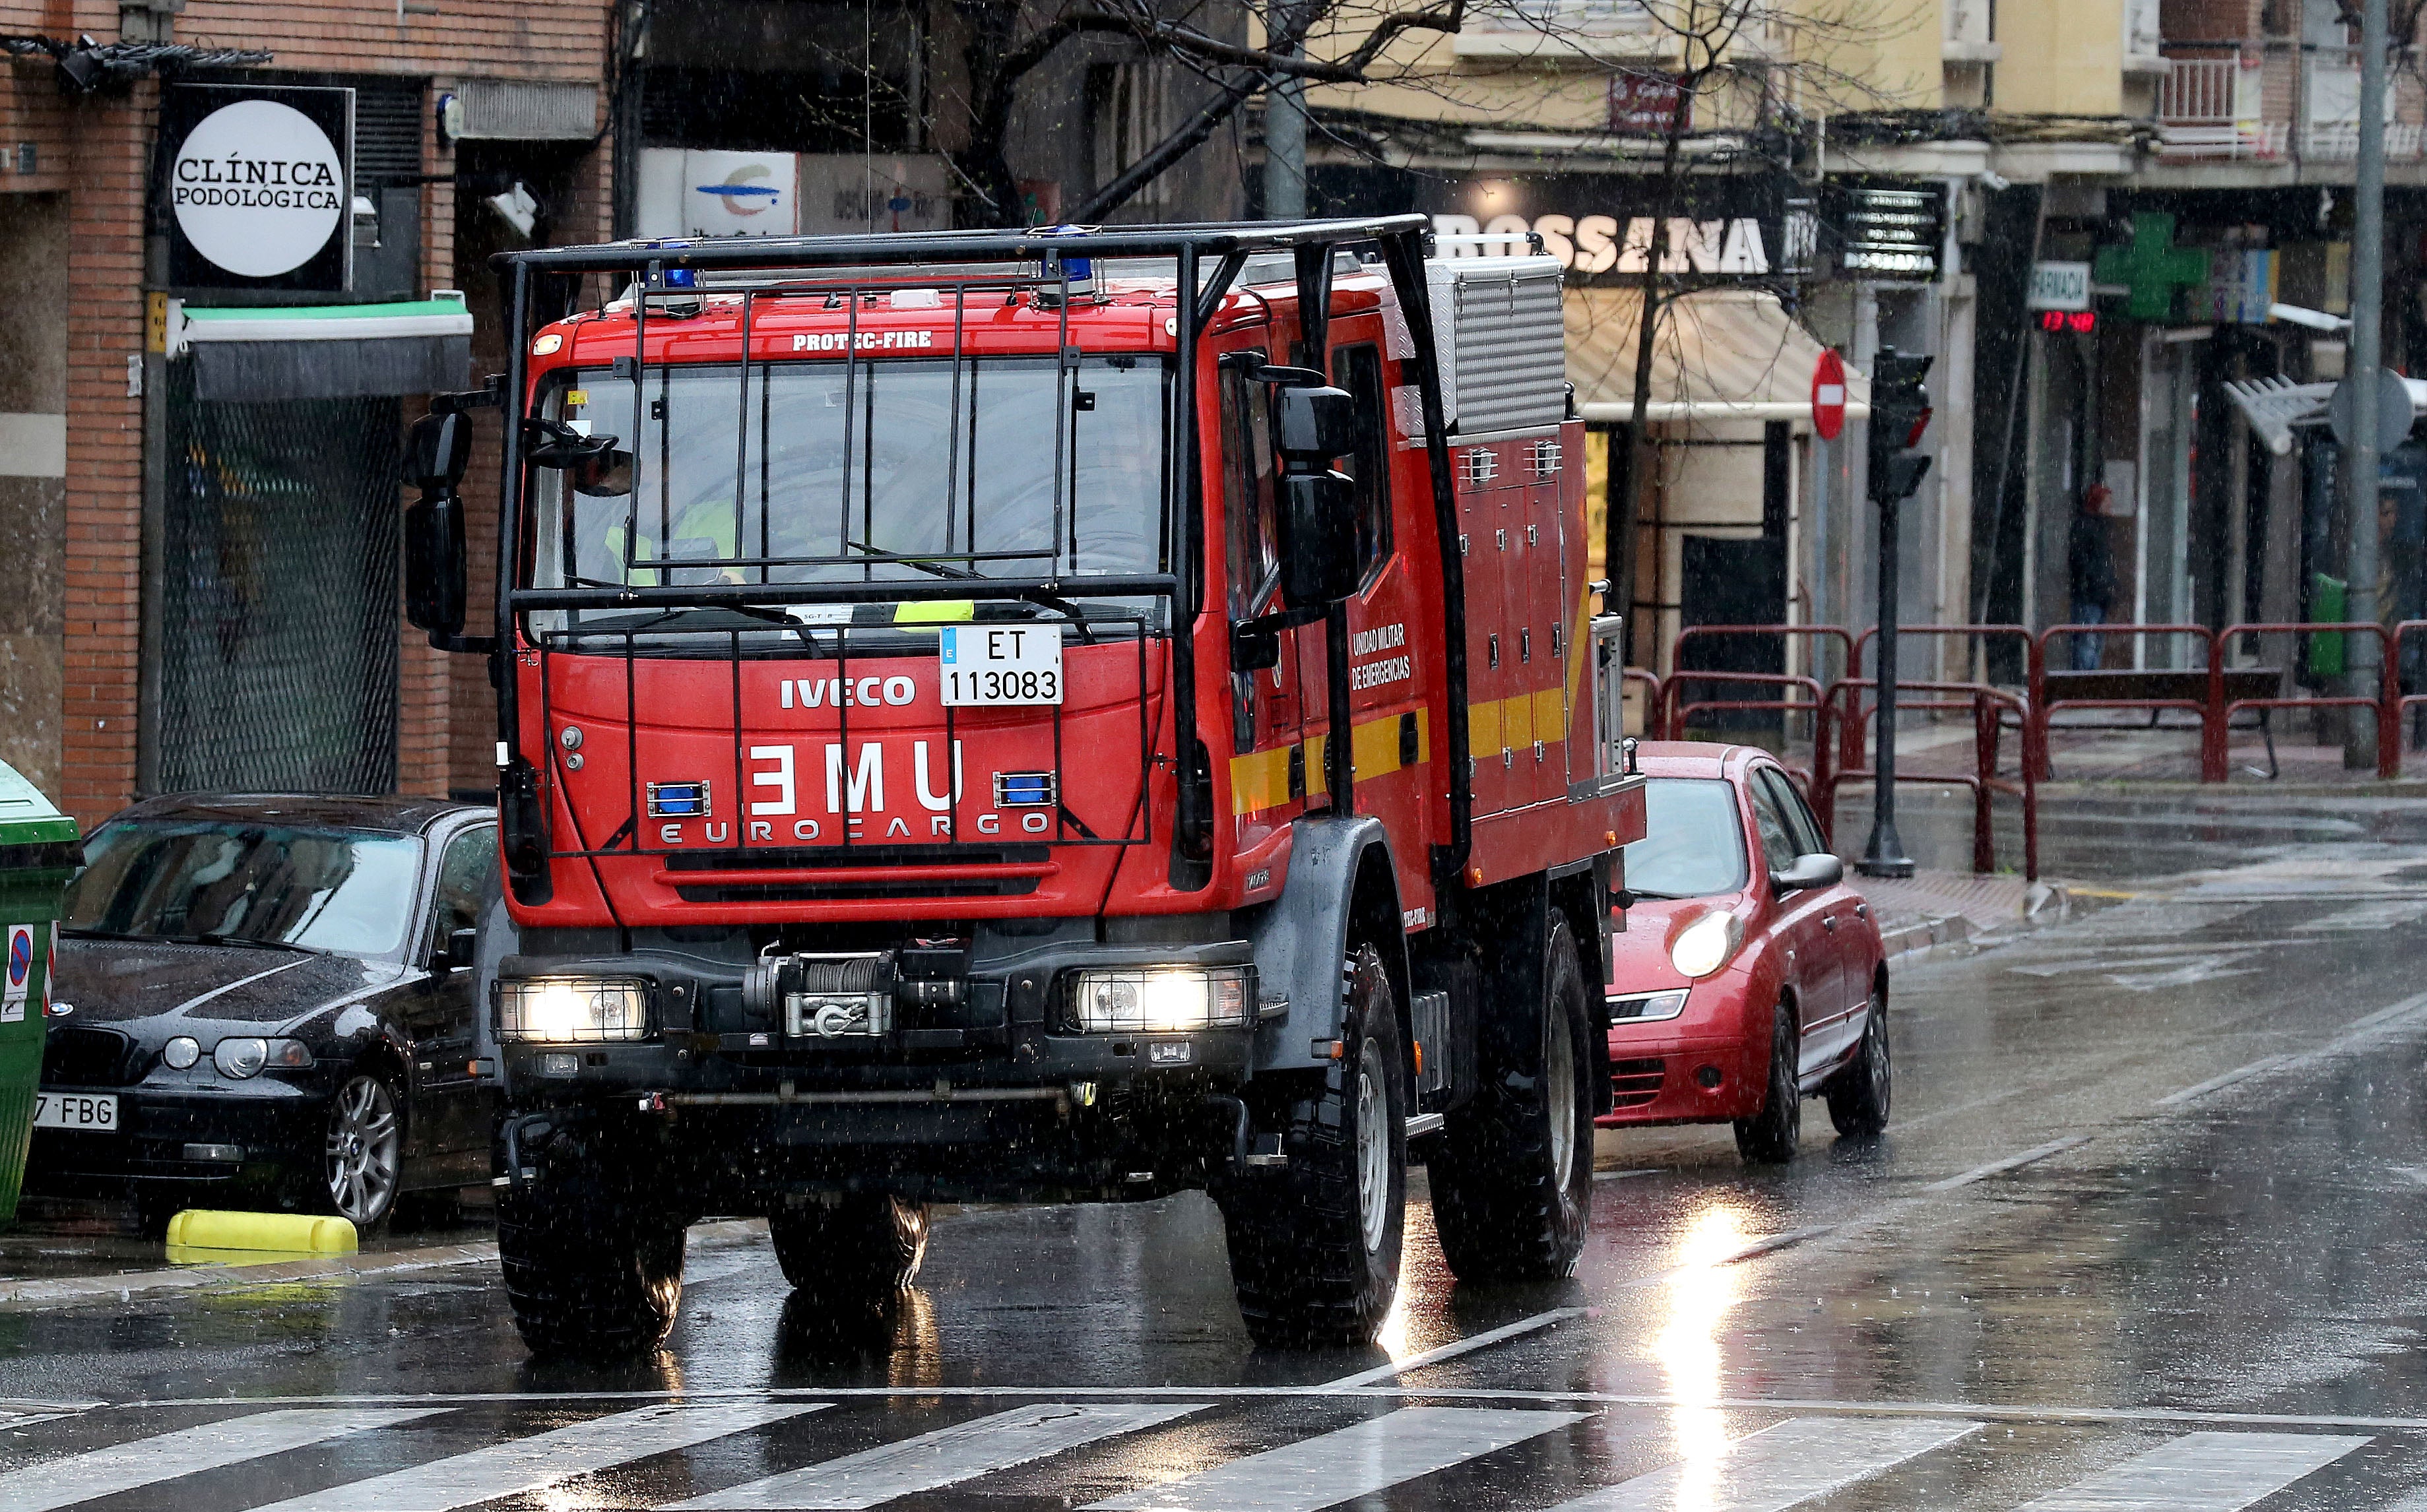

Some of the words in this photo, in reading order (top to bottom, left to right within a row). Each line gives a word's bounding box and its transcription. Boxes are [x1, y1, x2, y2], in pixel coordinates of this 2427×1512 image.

[178, 151, 335, 186] CLÍNICA
[175, 183, 340, 209] PODOLÓGICA
[1431, 214, 1769, 274] ROSSANA
[793, 331, 932, 351] PROTEC-FIRE
[946, 649, 953, 658] E
[988, 631, 1026, 660] ET
[1353, 629, 1378, 656] UNIDAD
[1377, 623, 1406, 650] MILITAR
[950, 671, 1056, 700] 113083
[1351, 666, 1363, 691] DE
[1361, 655, 1411, 689] EMERGENCIAS
[781, 676, 916, 709] IVECO
[660, 812, 1049, 844] EUROCARGO
[62, 1098, 112, 1124] FBG
